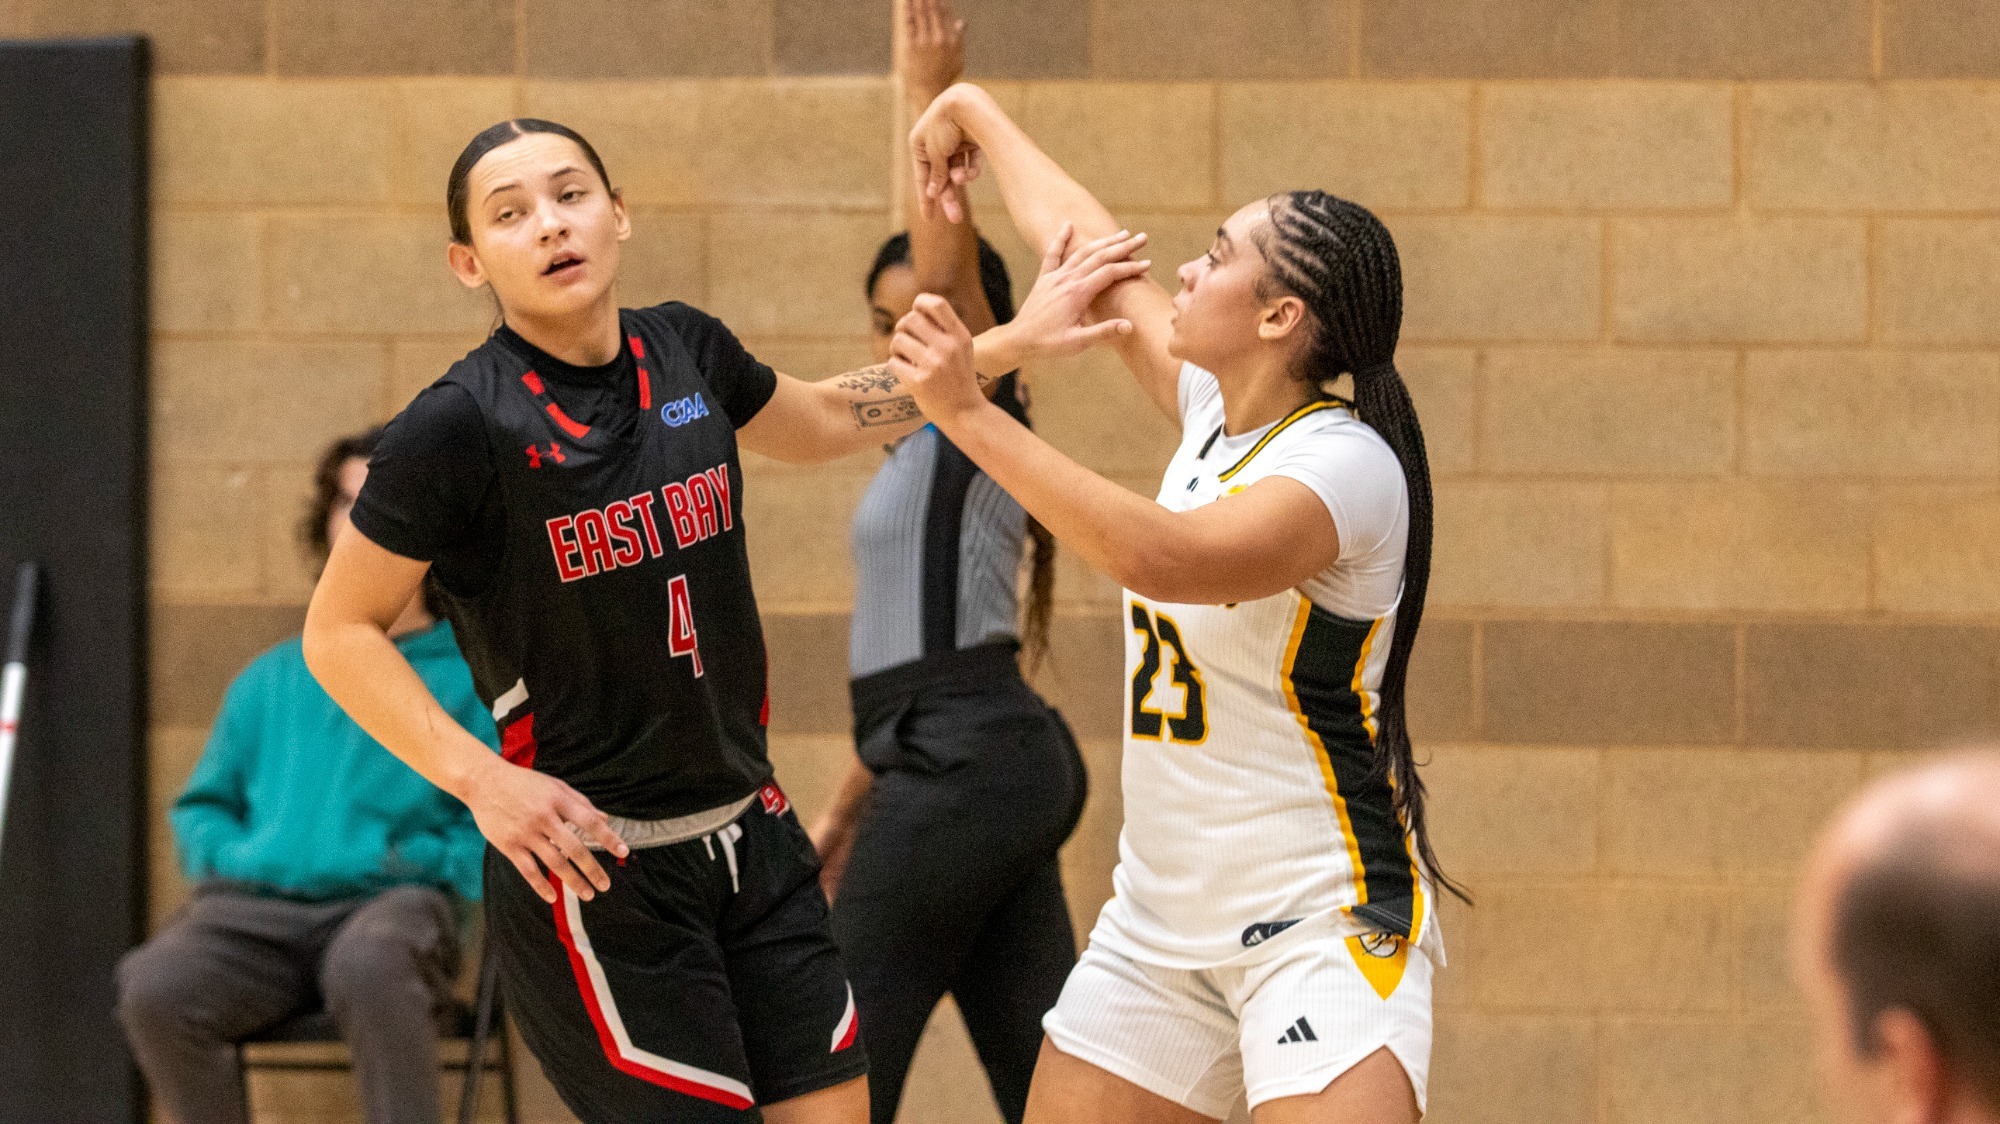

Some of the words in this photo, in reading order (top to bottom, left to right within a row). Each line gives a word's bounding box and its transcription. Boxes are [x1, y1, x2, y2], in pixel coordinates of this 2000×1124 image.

[546, 491, 663, 583] EAST
[661, 463, 732, 549] BAY
[668, 574, 703, 678] 4
[1131, 600, 1210, 746] 23
